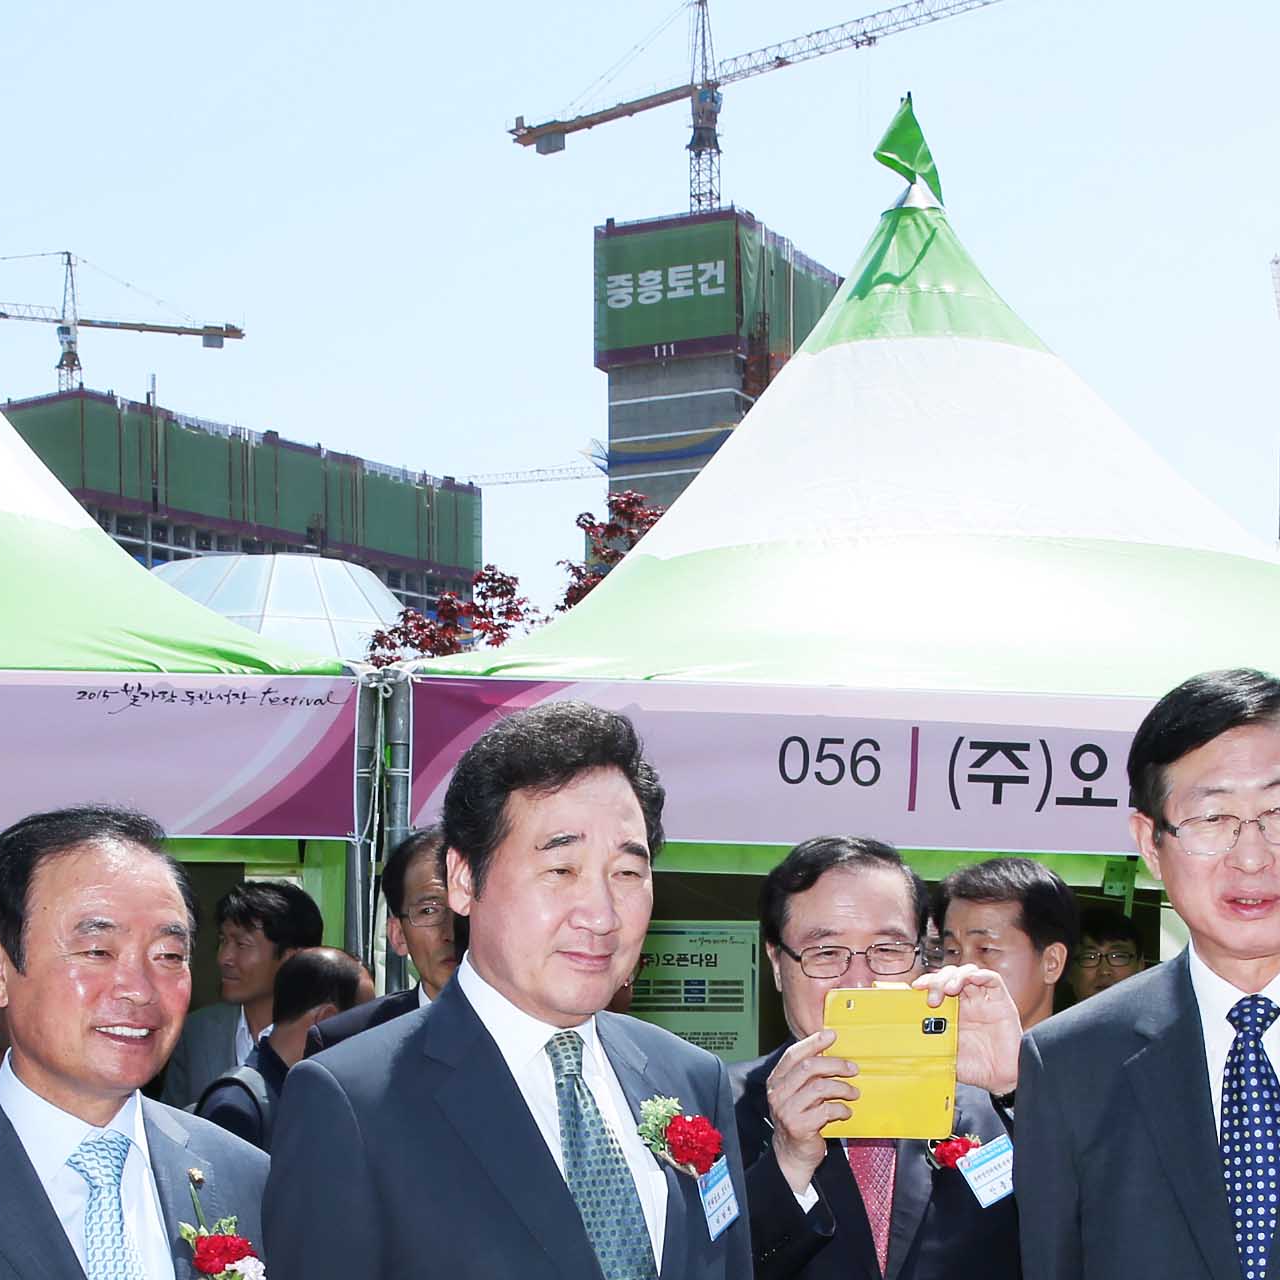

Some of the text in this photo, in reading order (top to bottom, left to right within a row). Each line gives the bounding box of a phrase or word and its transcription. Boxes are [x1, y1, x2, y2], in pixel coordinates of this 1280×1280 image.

[606, 260, 726, 309] 중흥토건
[654, 343, 675, 358] 111
[778, 735, 1136, 812] 056 (주)오
[642, 953, 718, 968] 주)오픈다임
